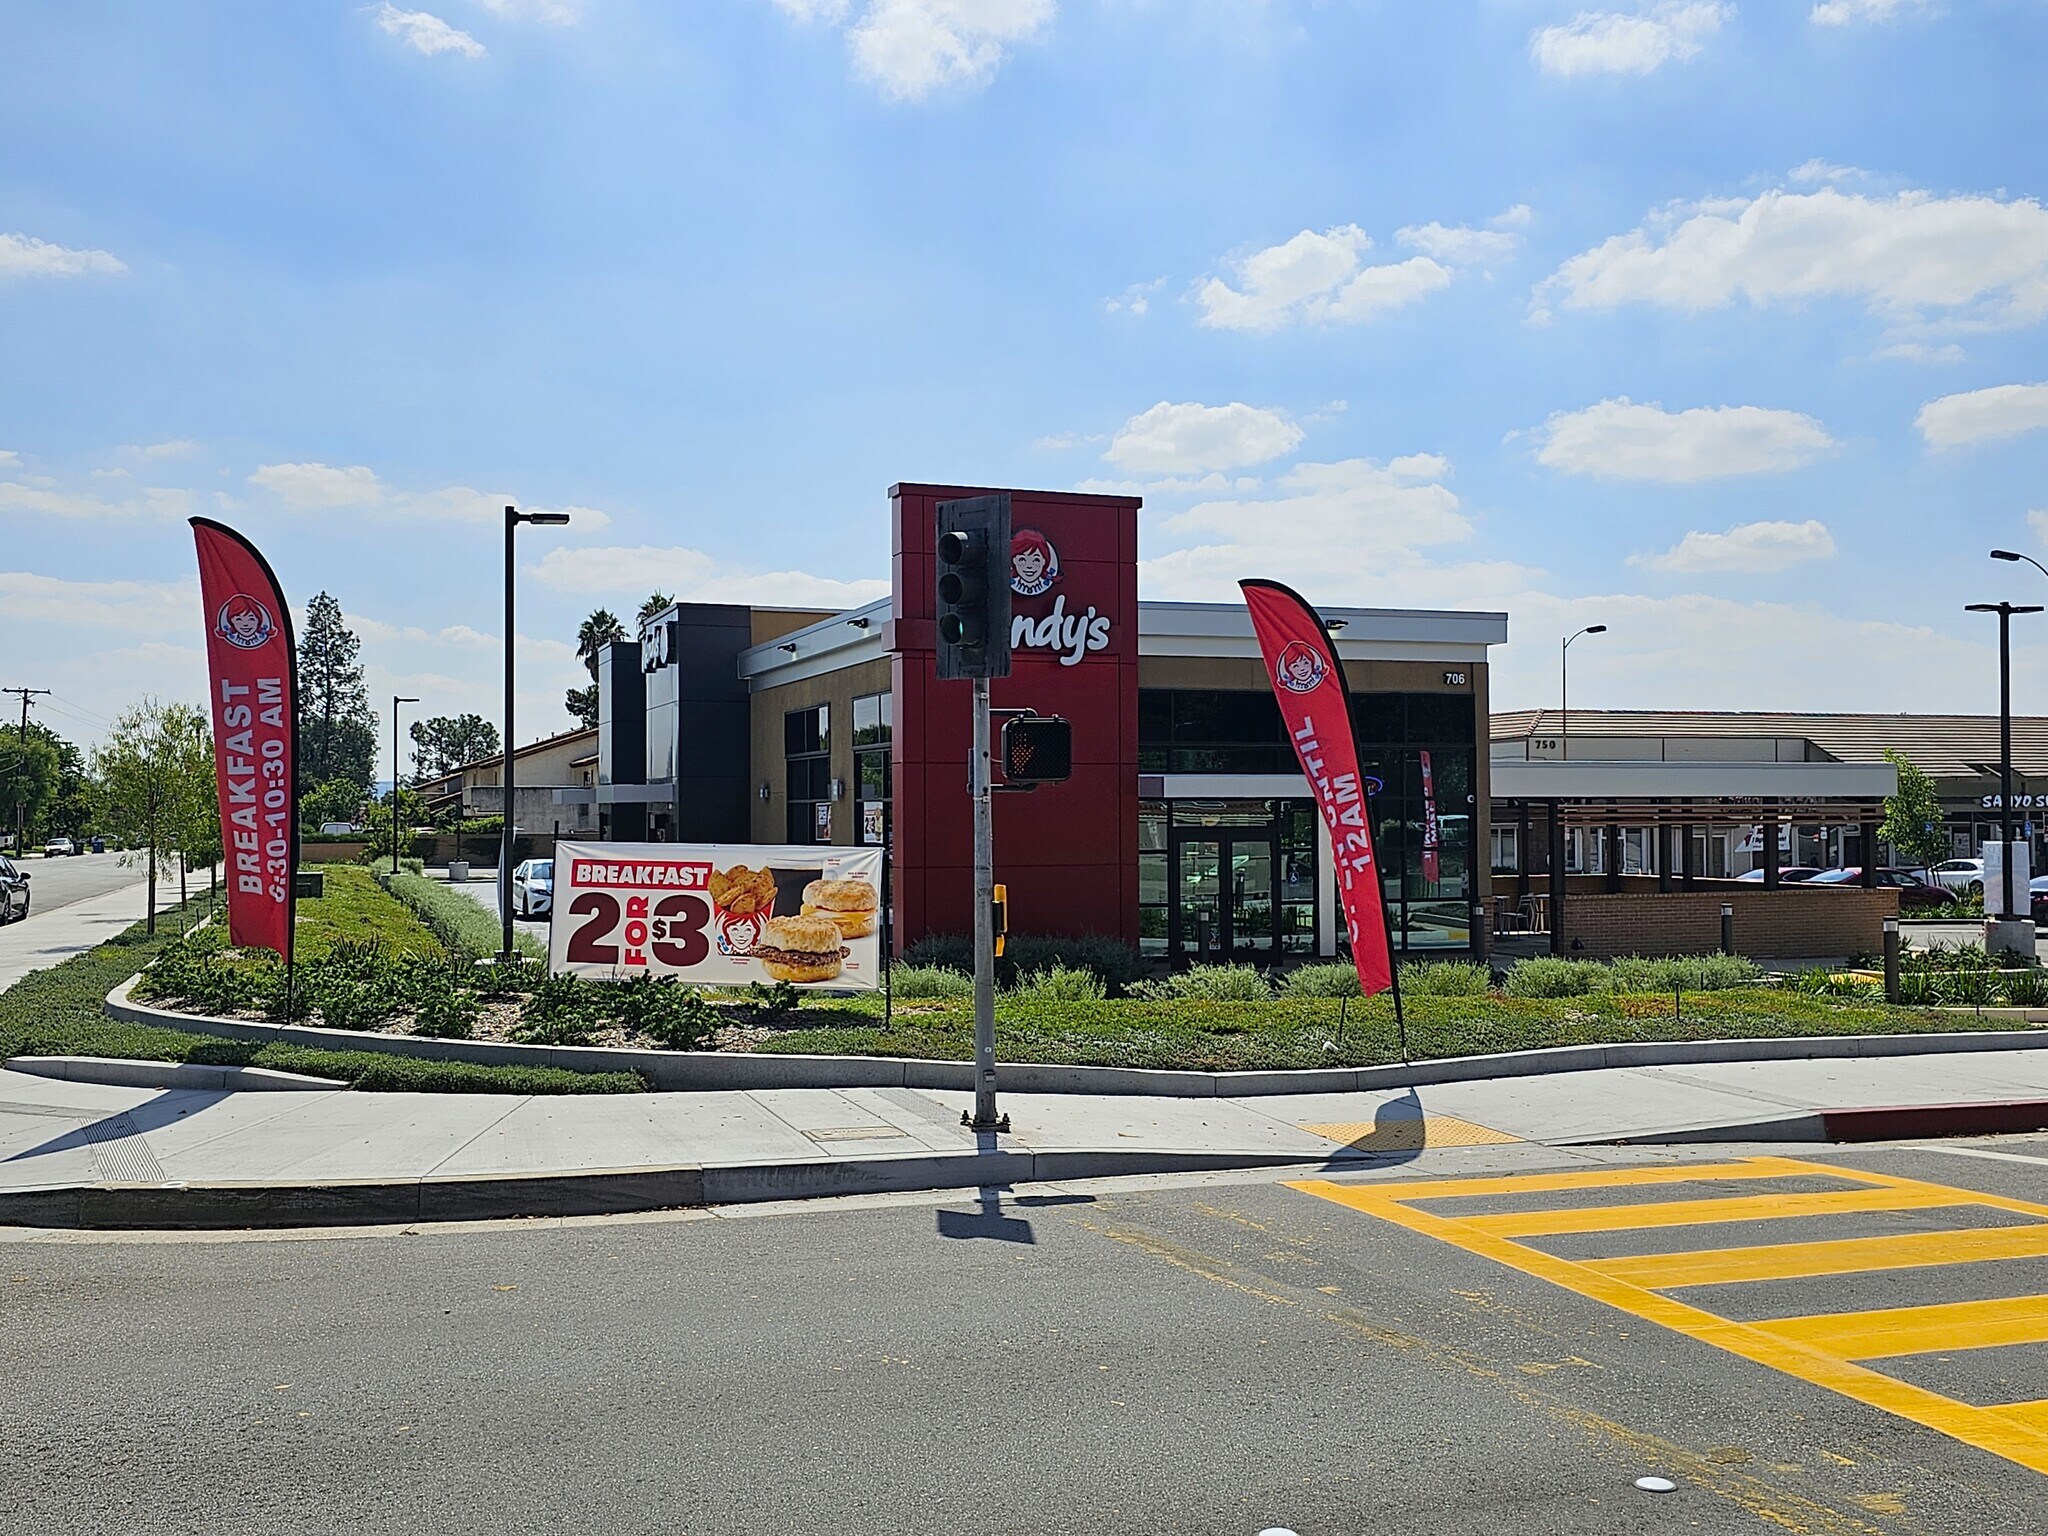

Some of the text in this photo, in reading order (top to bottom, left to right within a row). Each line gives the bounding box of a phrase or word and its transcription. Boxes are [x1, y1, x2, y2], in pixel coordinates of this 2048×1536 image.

[1011, 594, 1110, 666] ndy's
[1445, 673, 1466, 685] 706
[257, 678, 283, 728] AM
[1535, 740, 1556, 750] 750
[222, 678, 263, 896] BREAKFAST
[1982, 795, 2048, 808] SAYO S
[576, 864, 709, 886] BREAKFAST
[566, 892, 621, 965] 2
[624, 896, 649, 966] FOR
